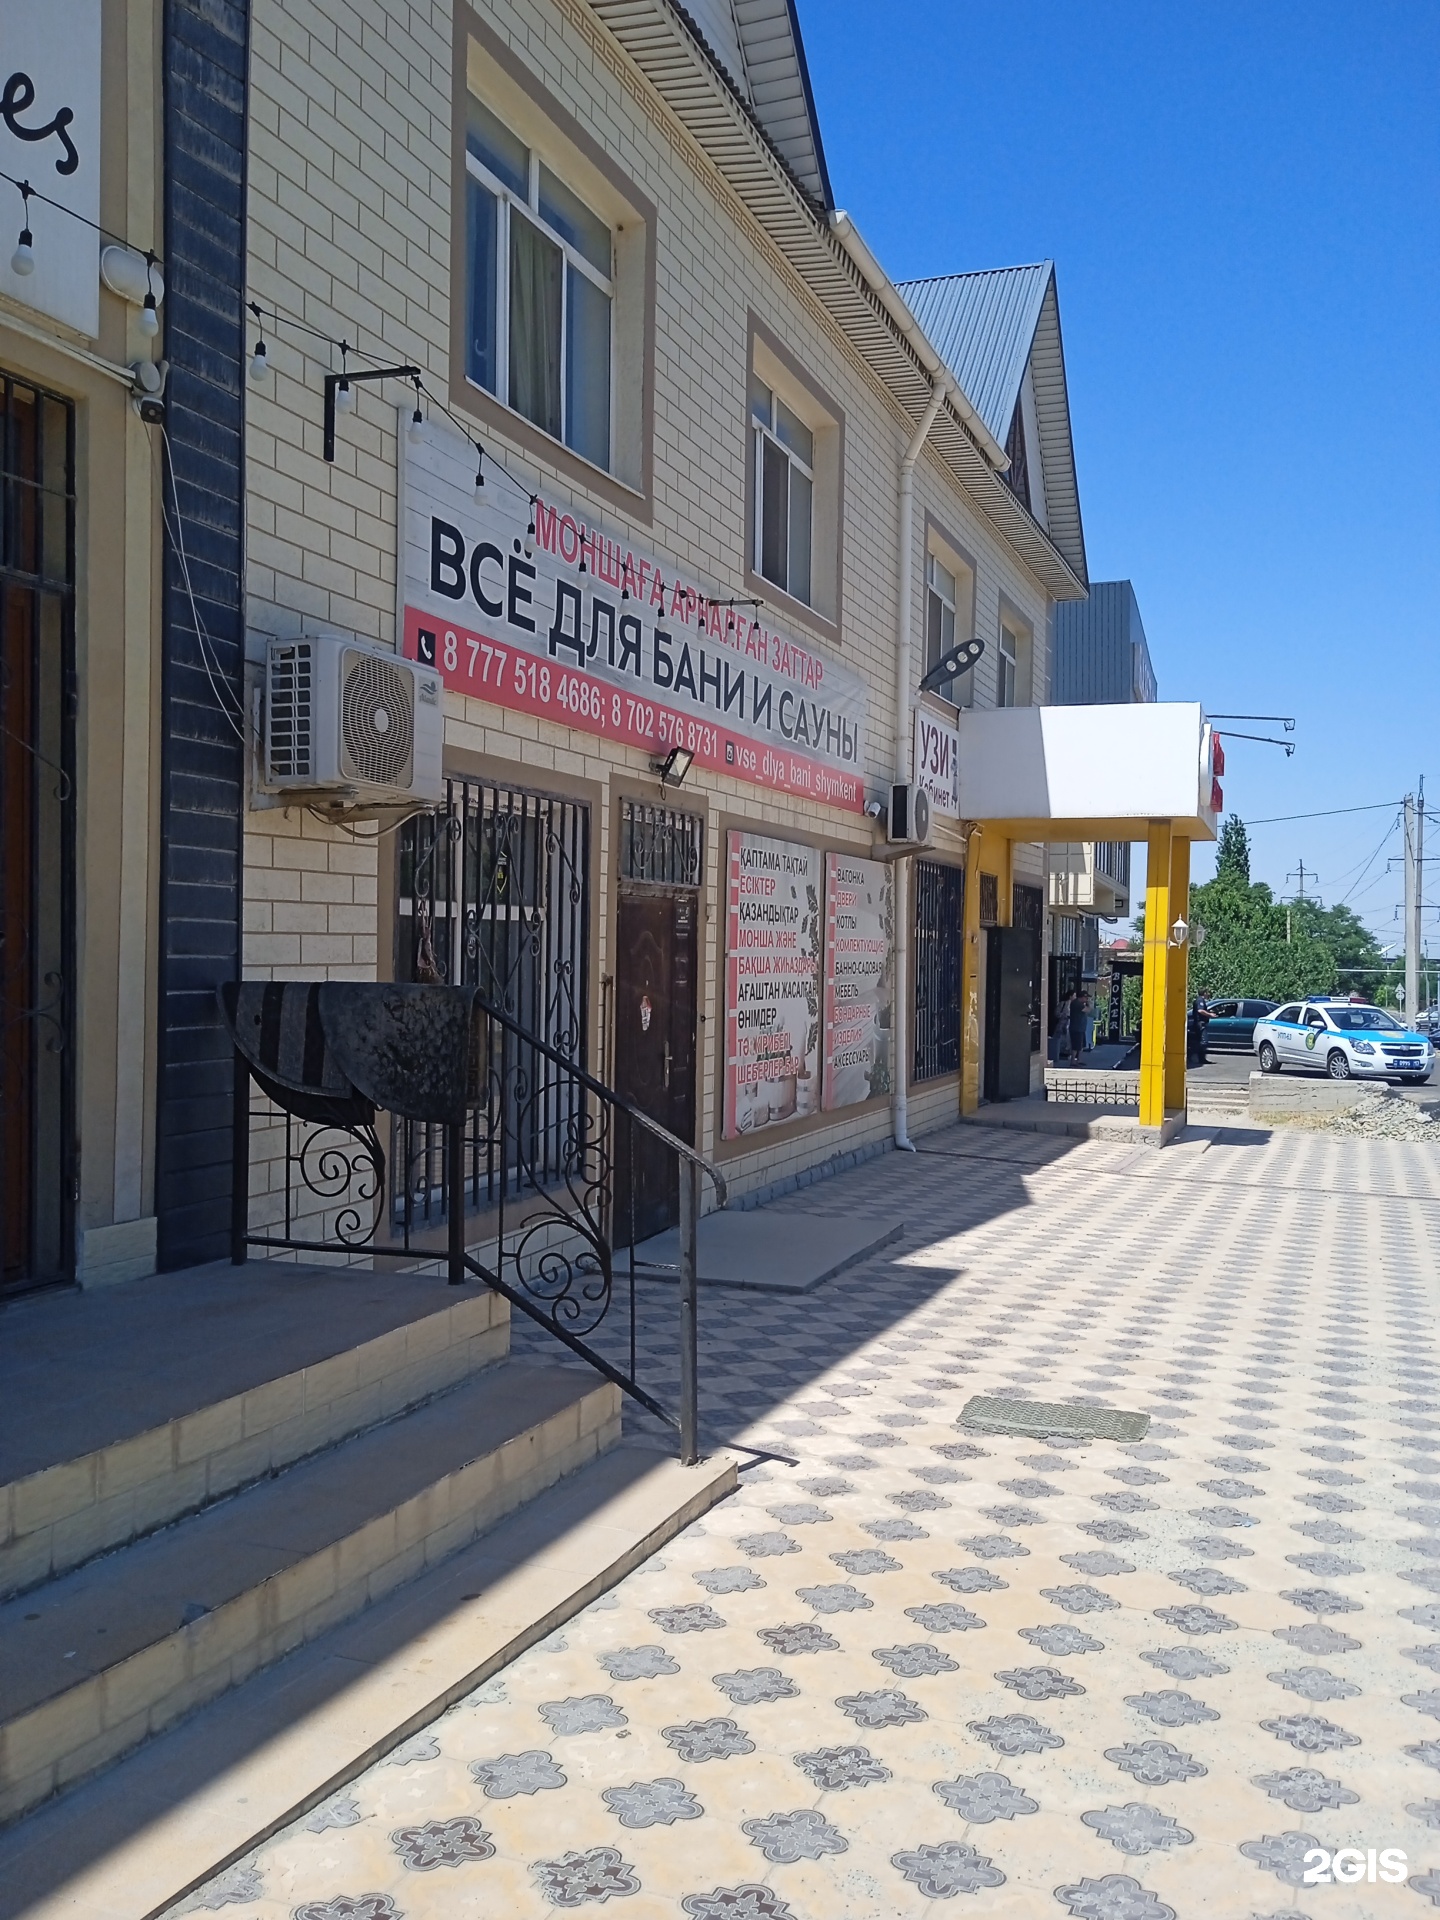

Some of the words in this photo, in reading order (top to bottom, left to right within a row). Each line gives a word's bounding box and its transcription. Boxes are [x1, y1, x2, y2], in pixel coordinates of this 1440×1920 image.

[535, 498, 665, 612] МОНШАҒА
[772, 635, 823, 691] ЗАТТАР
[430, 515, 536, 633] ВСЁ
[548, 578, 642, 677] ДЛЯ
[653, 628, 745, 720] БАНИ
[752, 675, 772, 730] И
[779, 690, 858, 764] САУНЫ
[444, 631, 458, 671] 8
[466, 638, 507, 687] 777
[514, 656, 551, 703] 518
[556, 674, 605, 728] 4686;
[611, 694, 621, 727] 8
[626, 698, 654, 738] 702
[658, 711, 684, 747] 576
[687, 721, 717, 758] 8731
[921, 720, 949, 779] УЗИ
[735, 745, 857, 802] vse_dlya_bani_shymkent
[740, 848, 781, 871] ҚАПТАМА
[782, 855, 808, 877] ТАҚТАЙ
[740, 875, 776, 896] ЕСІКТЕР
[837, 868, 865, 885] ВАГОНКА
[837, 891, 857, 907] ДВЕРИ
[739, 902, 799, 926] ҚАЗАНДЫҚТАР
[836, 915, 857, 929] КОТЛЫ
[739, 929, 774, 948] МОНША
[775, 930, 797, 949] ЖӘНЕ
[738, 956, 771, 977] БАҚША
[738, 982, 779, 1001] АҒАШТАН
[834, 984, 859, 998] МЕБЕЛЬ
[1110, 972, 1120, 1030] BOXER
[738, 1008, 777, 1030] ӨНІМДЕР
[834, 1028, 862, 1045] ИЗДЕЛИЯ
[737, 1058, 784, 1084] ШЕБЕРЛЕР
[784, 1056, 800, 1075] БАР
